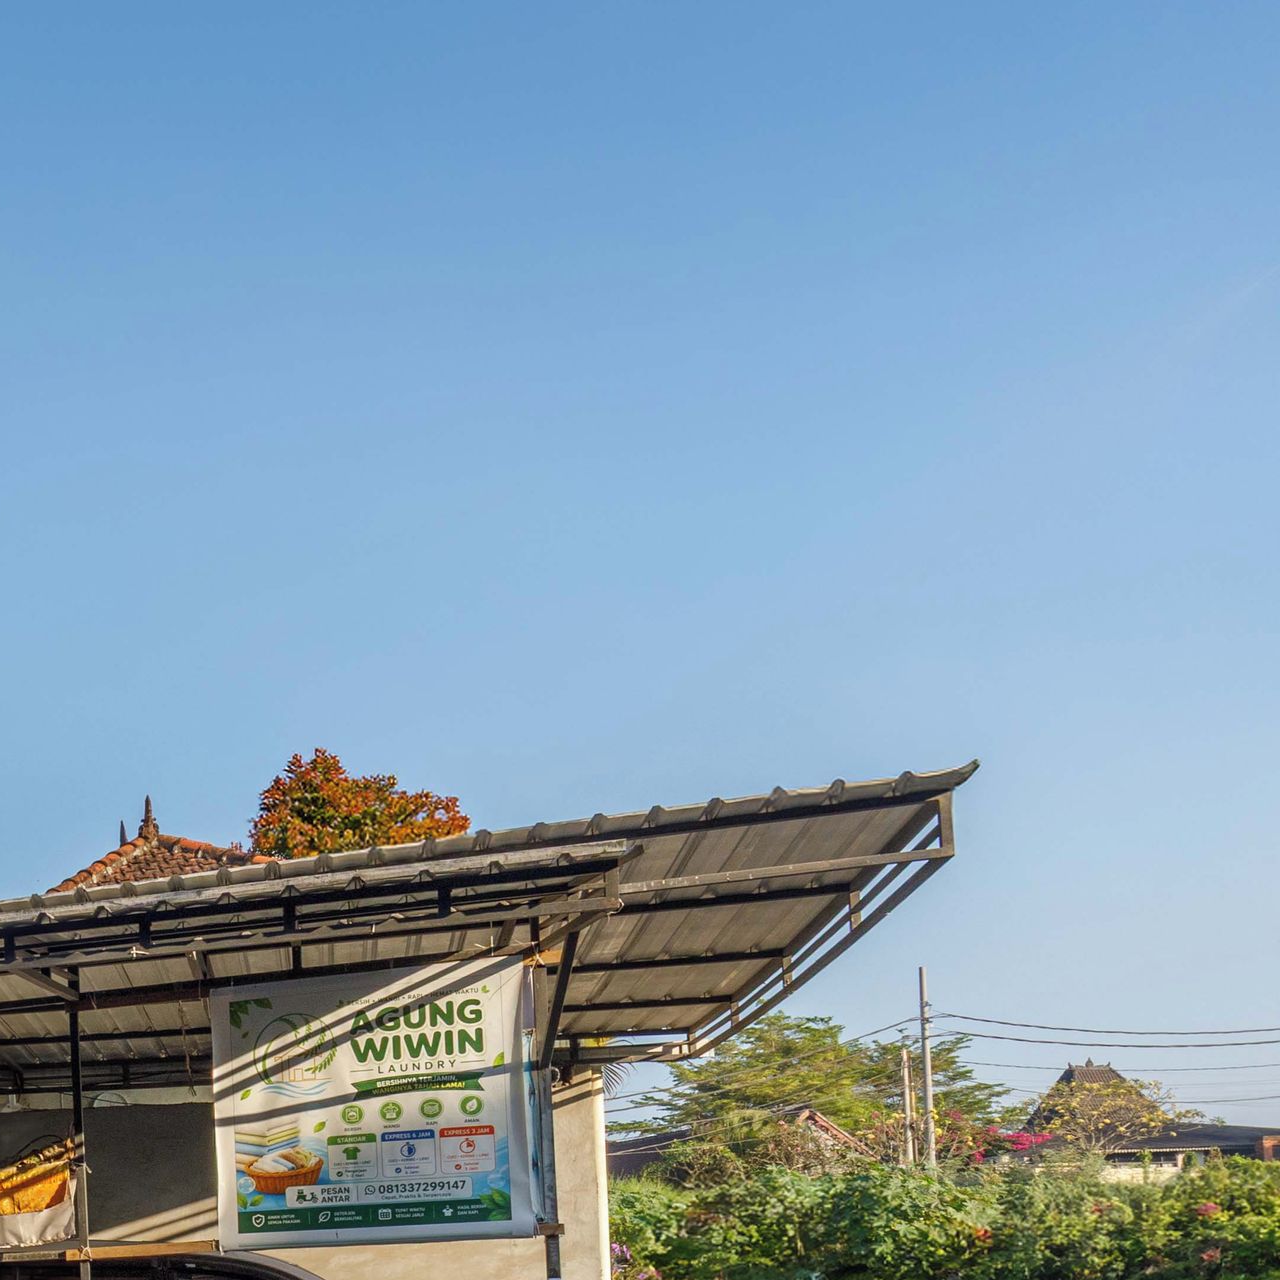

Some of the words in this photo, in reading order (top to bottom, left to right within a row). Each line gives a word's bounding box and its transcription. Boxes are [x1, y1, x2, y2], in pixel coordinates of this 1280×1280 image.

[455, 987, 479, 995] WAKTU
[349, 998, 483, 1036] AGUNG
[350, 1027, 484, 1064] WIWIN
[377, 1059, 457, 1074] LAUNDRY
[371, 1083, 414, 1095] WANGINYA
[414, 1081, 440, 1090] TAHAN
[440, 1081, 465, 1089] LAMA!
[376, 1076, 418, 1088] BERSIHNYA
[336, 1135, 367, 1144] STANDAR
[384, 1133, 411, 1141] EXPRESS
[320, 1186, 350, 1196] PESAN
[378, 1180, 466, 1194] 081337299147
[320, 1195, 351, 1204] ANTAR
